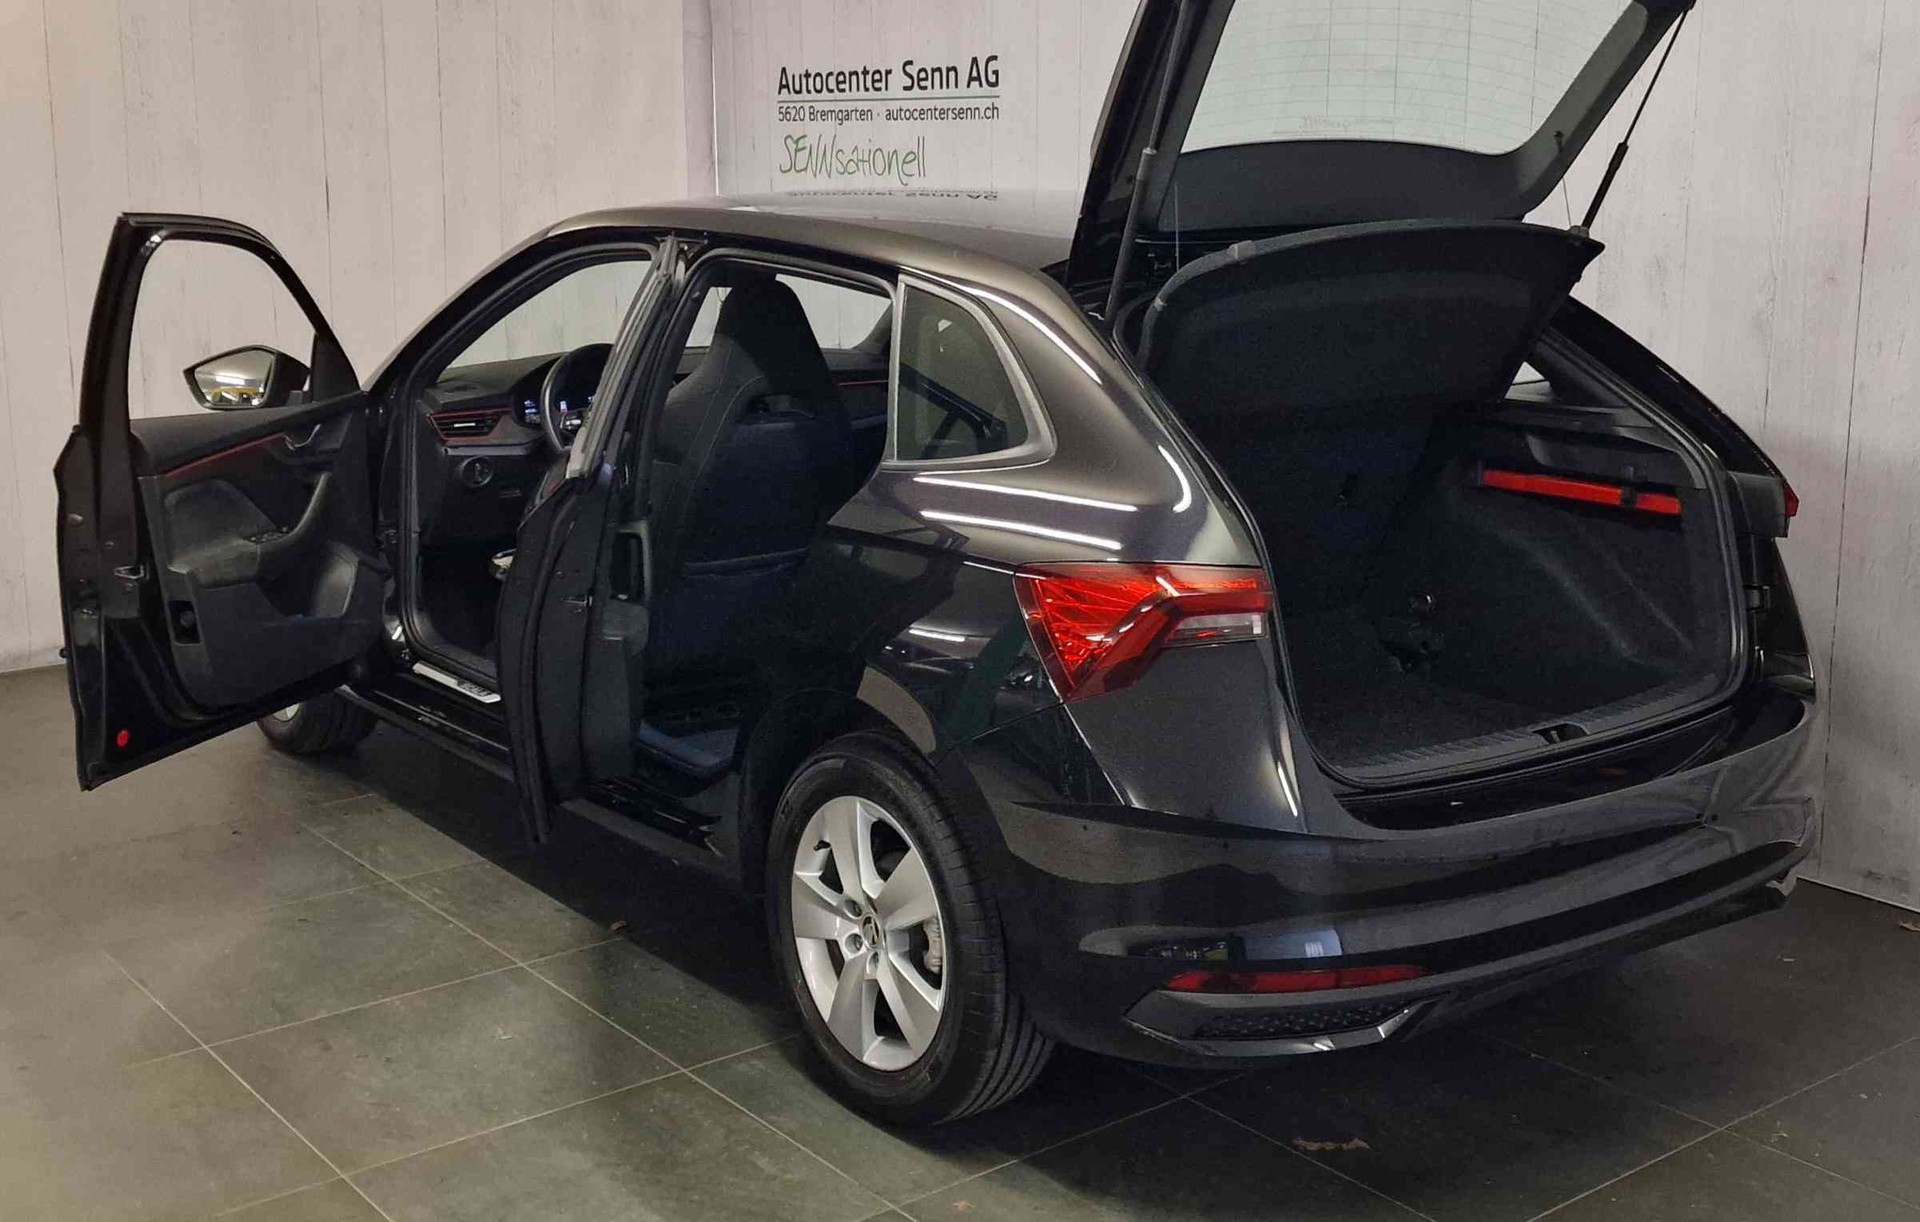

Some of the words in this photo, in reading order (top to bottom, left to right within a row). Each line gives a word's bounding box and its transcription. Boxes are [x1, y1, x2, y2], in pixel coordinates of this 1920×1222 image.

[778, 65, 893, 95] Autocenter
[902, 59, 958, 91] Senn
[966, 55, 999, 88] AG
[778, 105, 806, 122] 5620
[808, 105, 873, 126] Bremgarten
[885, 102, 999, 121] autocentersenn.ch
[779, 133, 927, 186] SENNsationell
